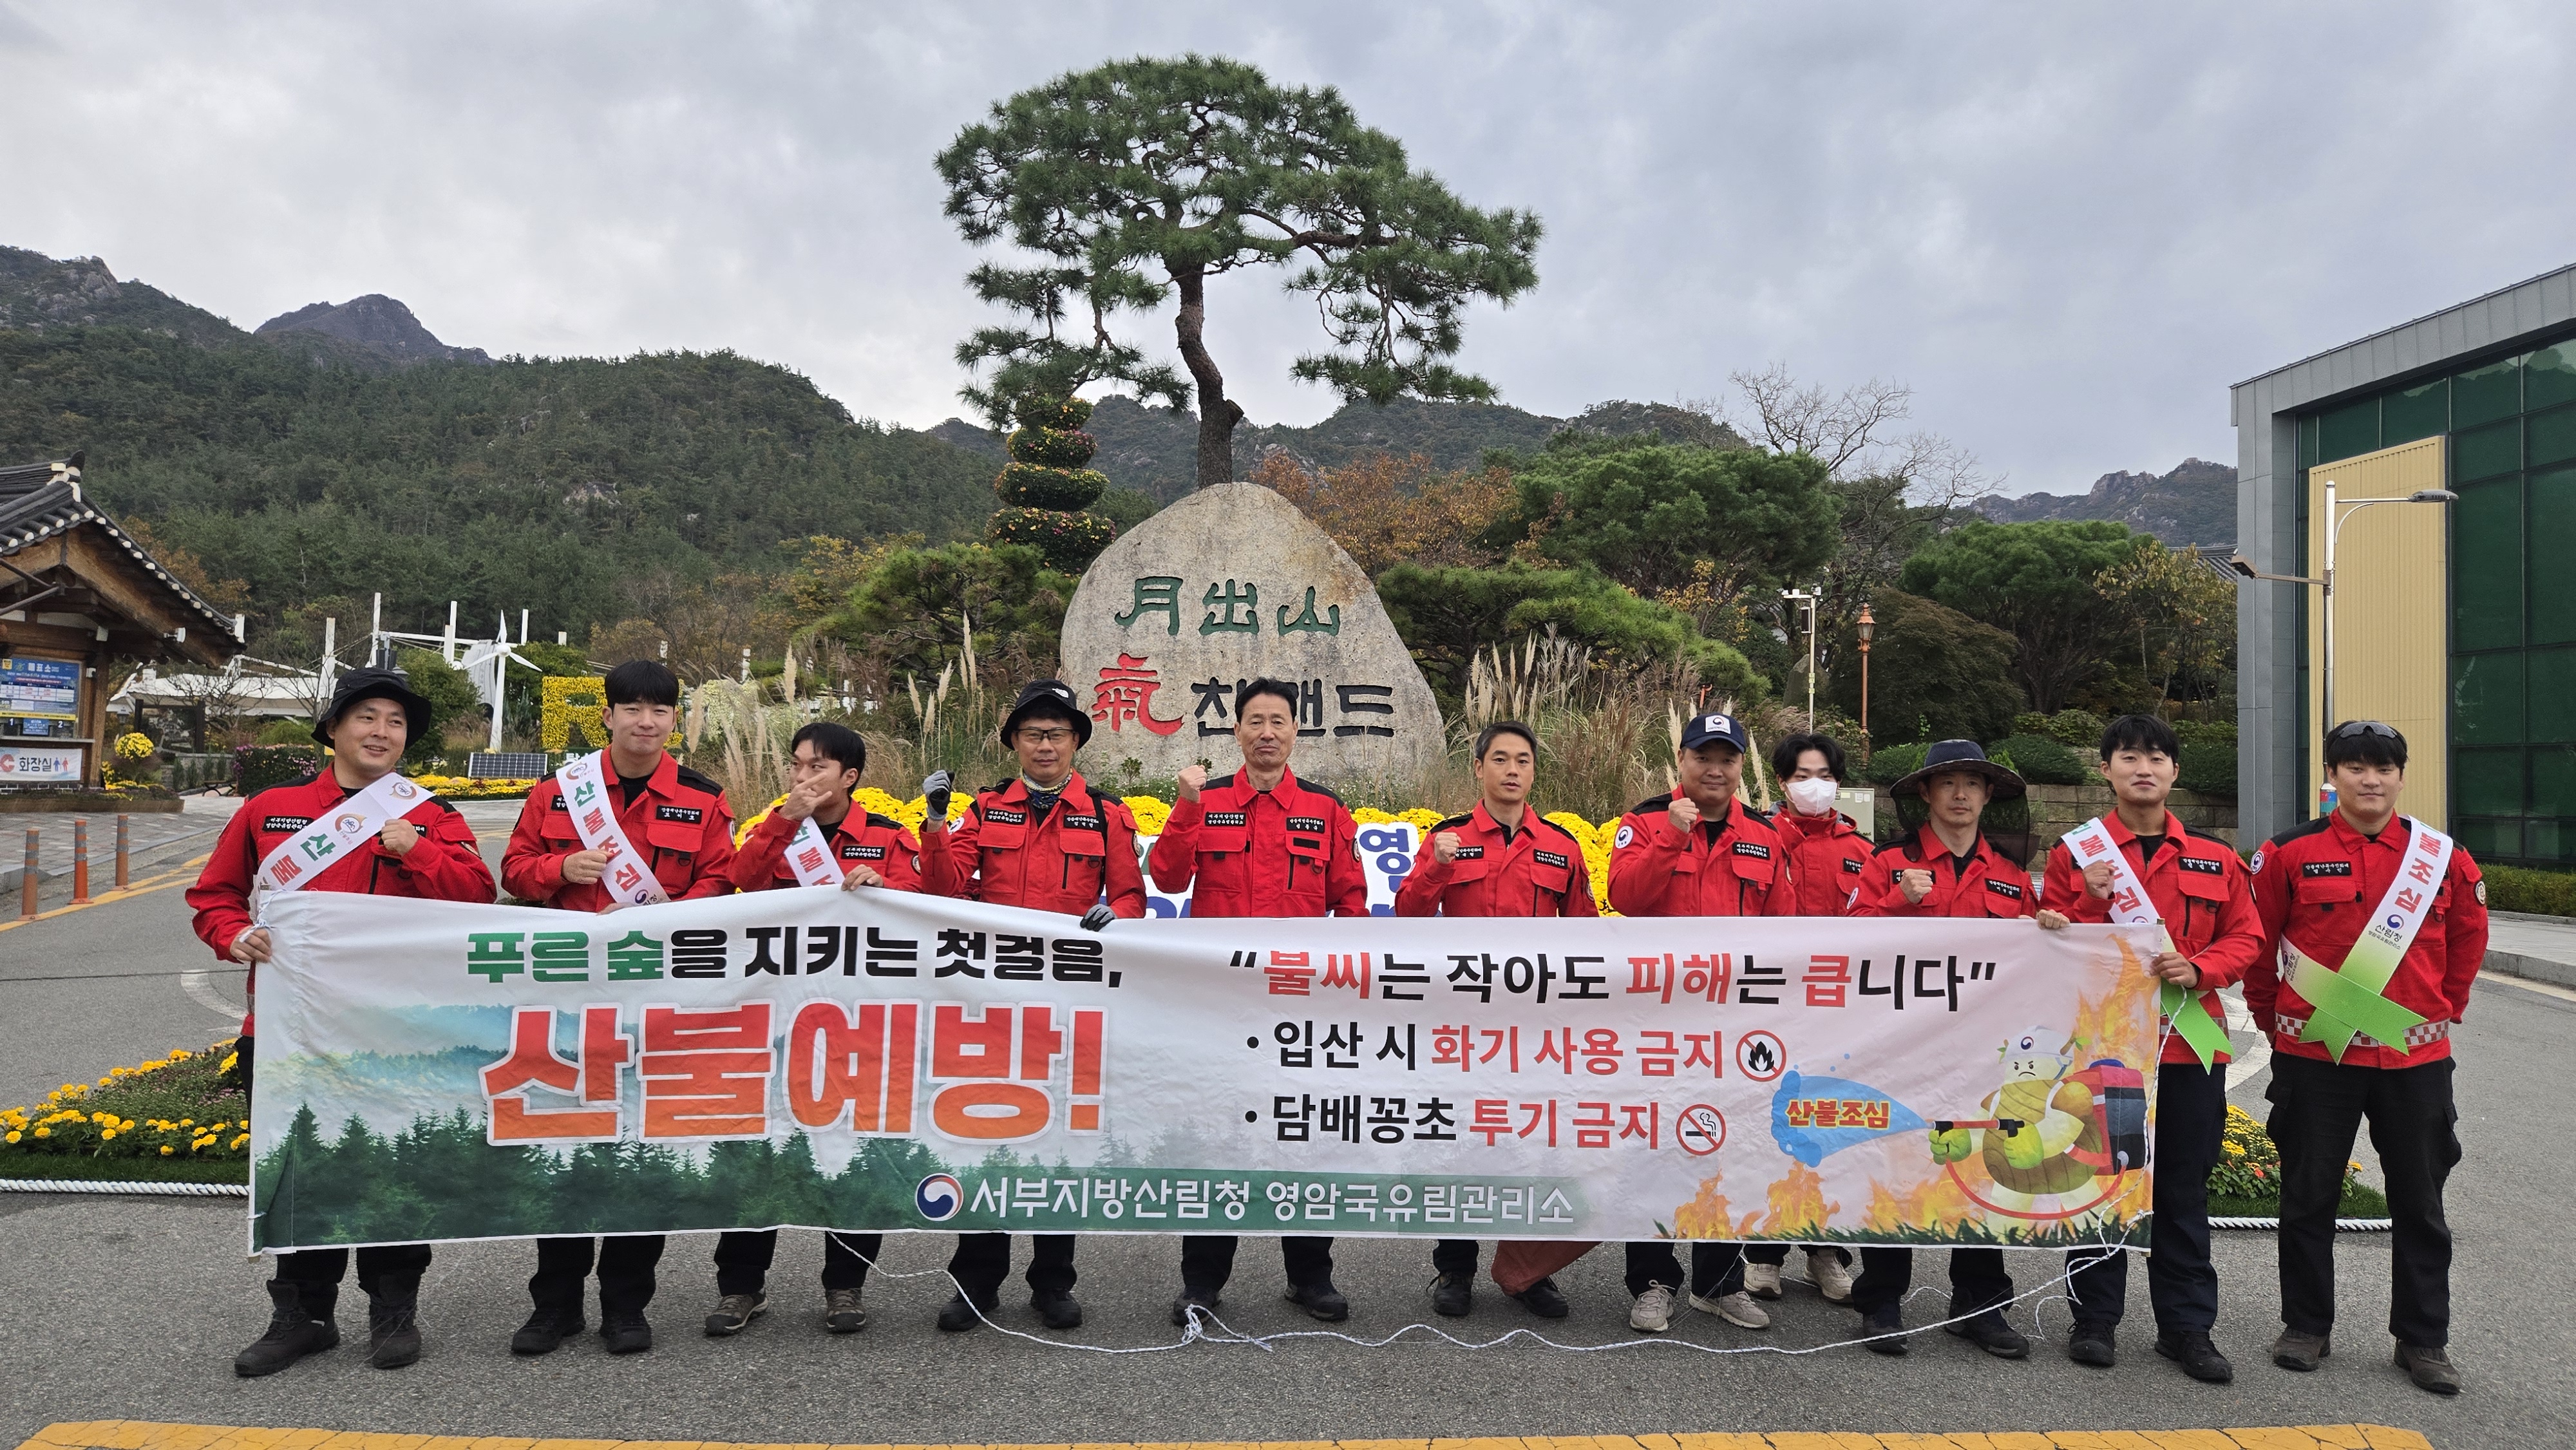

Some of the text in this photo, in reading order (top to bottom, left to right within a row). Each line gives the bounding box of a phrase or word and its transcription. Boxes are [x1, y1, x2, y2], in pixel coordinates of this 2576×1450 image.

[1115, 576, 1340, 636] 月出山
[19, 757, 52, 772] 화장실
[574, 780, 643, 892] 산불조심
[1359, 829, 1417, 874] 영
[2394, 822, 2442, 914] 불조심
[468, 925, 1122, 988] 푸른 숲을 지키는 첫걸음,
[2375, 925, 2403, 942] 산림청
[1446, 953, 1609, 1003] 작아도
[1626, 953, 1786, 1004] 피해는
[480, 999, 1108, 1145] 산불예방!
[1274, 1021, 1723, 1079] 입산 시 화기 사용 금지
[1273, 1094, 1658, 1150] 담배꽁초 투기 금지
[1785, 1099, 1891, 1130] 산불조심
[970, 1177, 1573, 1225] 서부지방산림청 영암국유림관리소
